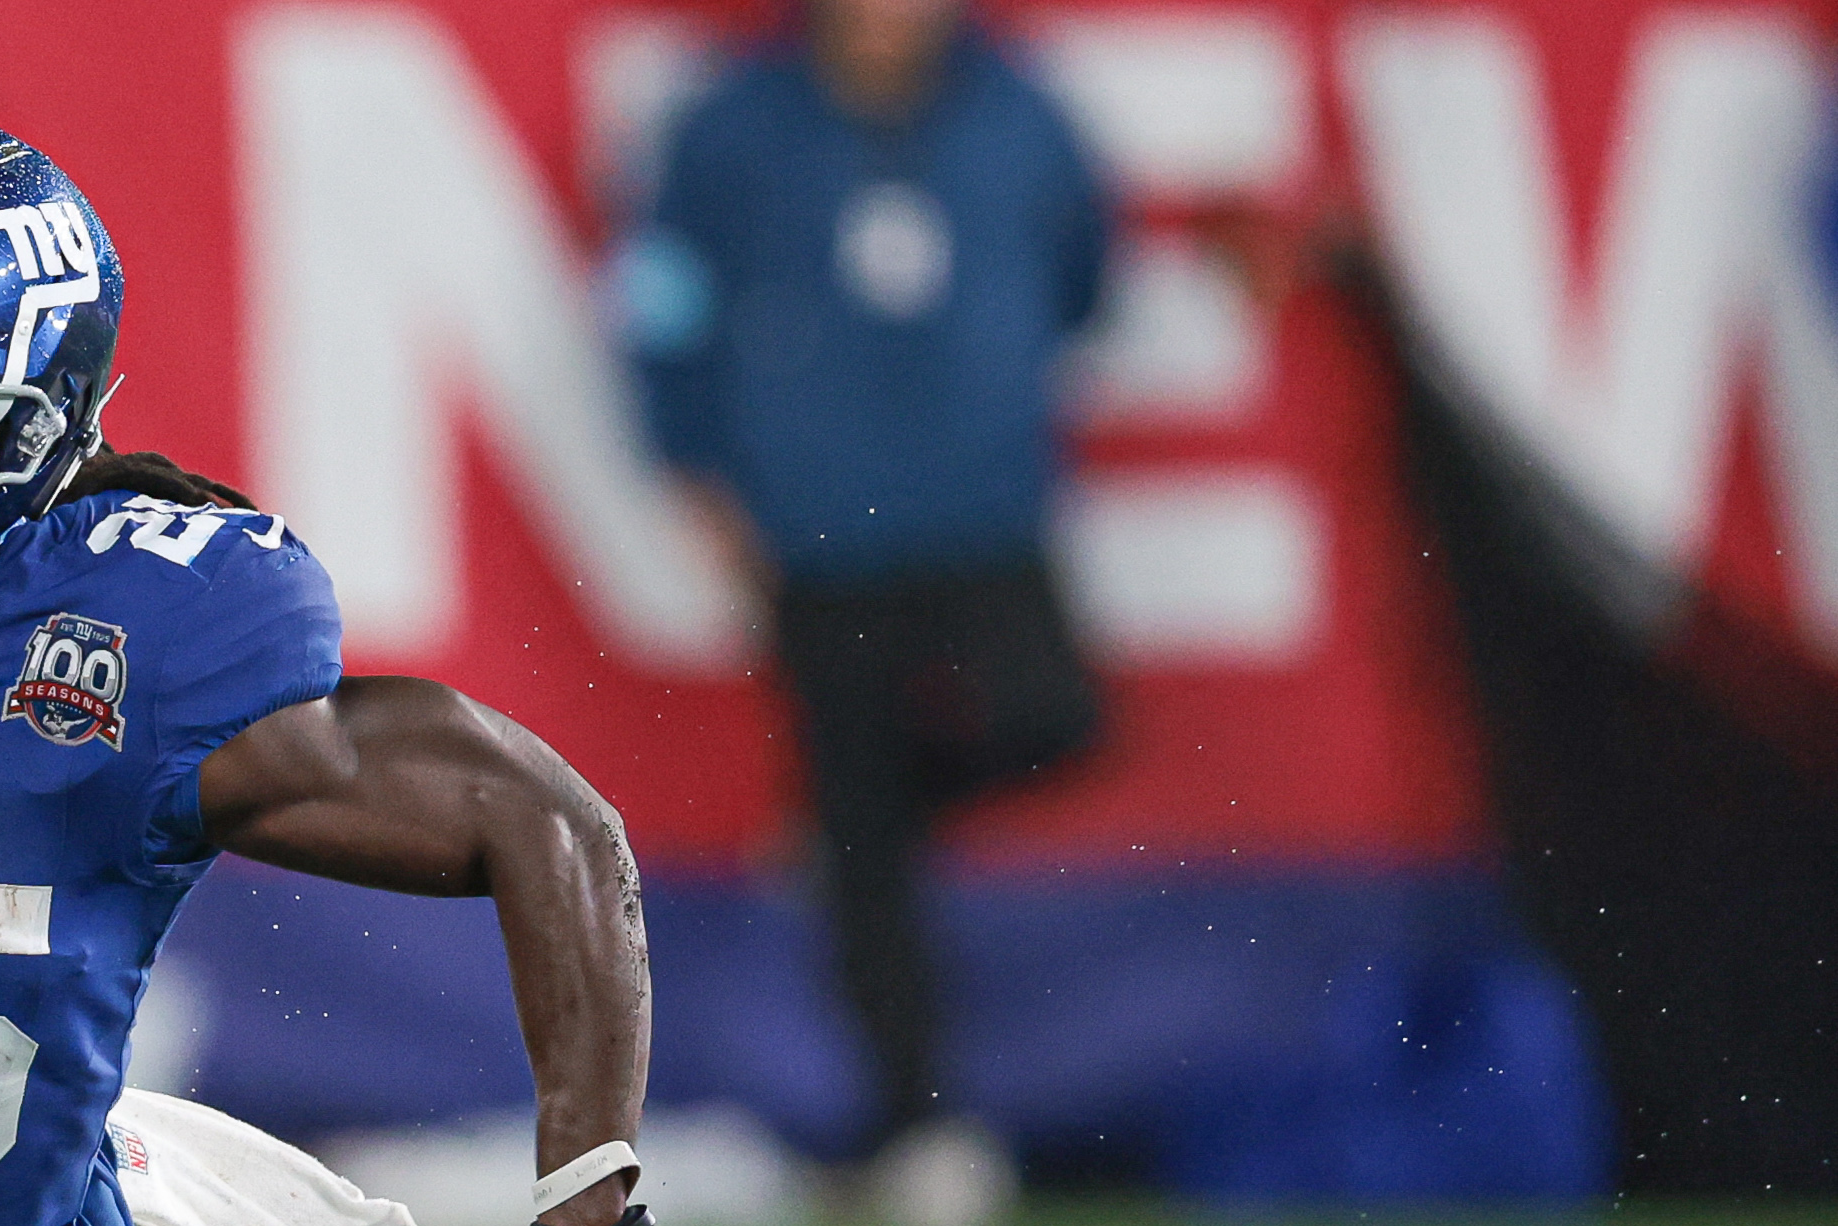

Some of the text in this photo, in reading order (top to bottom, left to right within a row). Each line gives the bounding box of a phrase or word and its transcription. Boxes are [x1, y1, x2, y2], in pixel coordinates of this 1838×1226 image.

[24, 631, 119, 702] 100
[25, 684, 104, 716] SEASONS
[125, 1136, 147, 1171] NFL
